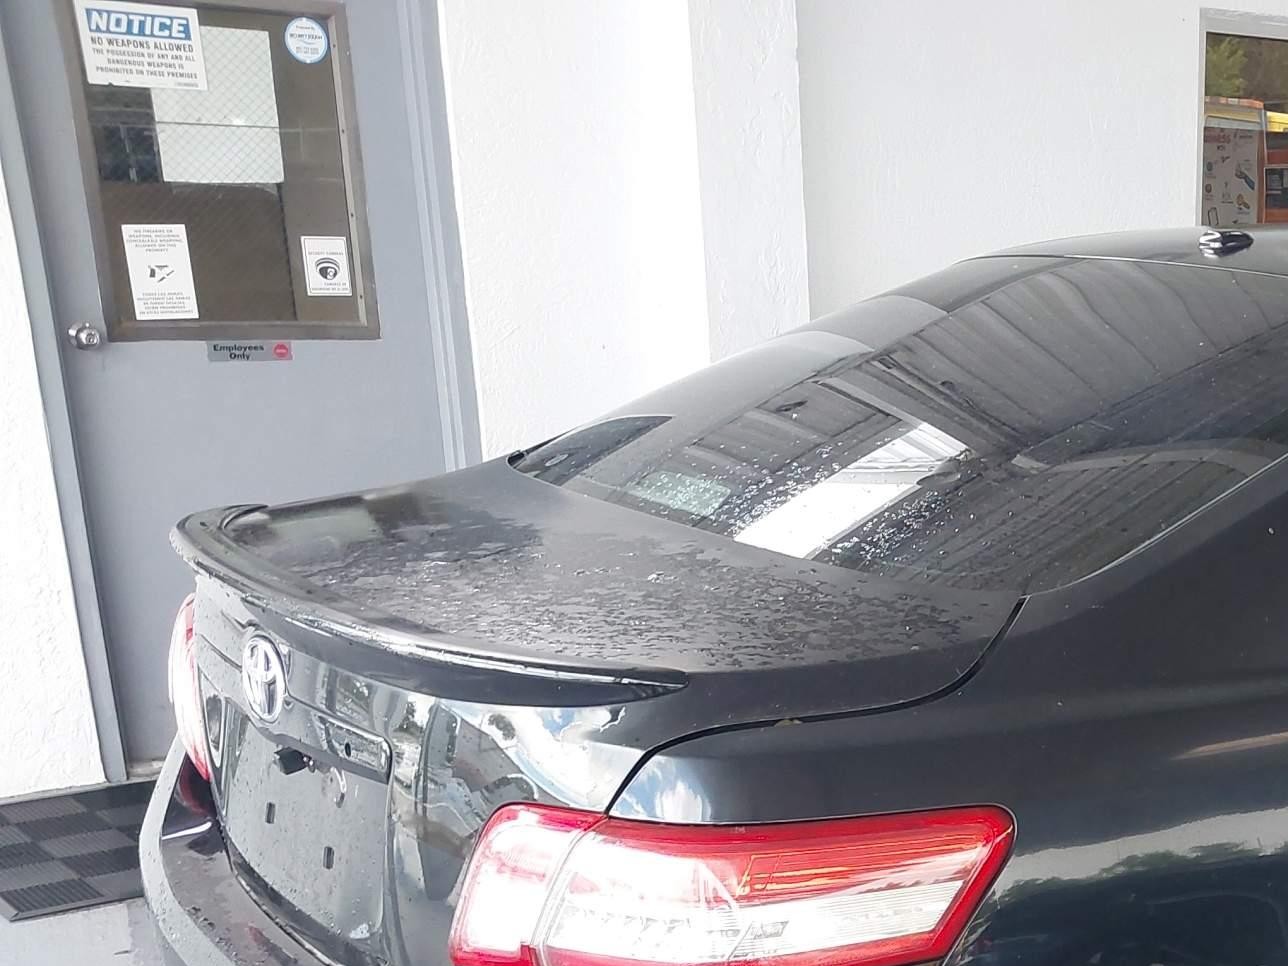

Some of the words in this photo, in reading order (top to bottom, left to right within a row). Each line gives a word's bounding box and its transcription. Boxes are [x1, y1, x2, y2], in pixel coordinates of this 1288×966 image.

[89, 10, 187, 38] NOTICE
[90, 36, 103, 46] NO
[106, 38, 151, 50] WEAPONS
[153, 42, 194, 53] ALLOWED
[213, 344, 265, 352] Employees
[229, 352, 250, 361] Only
